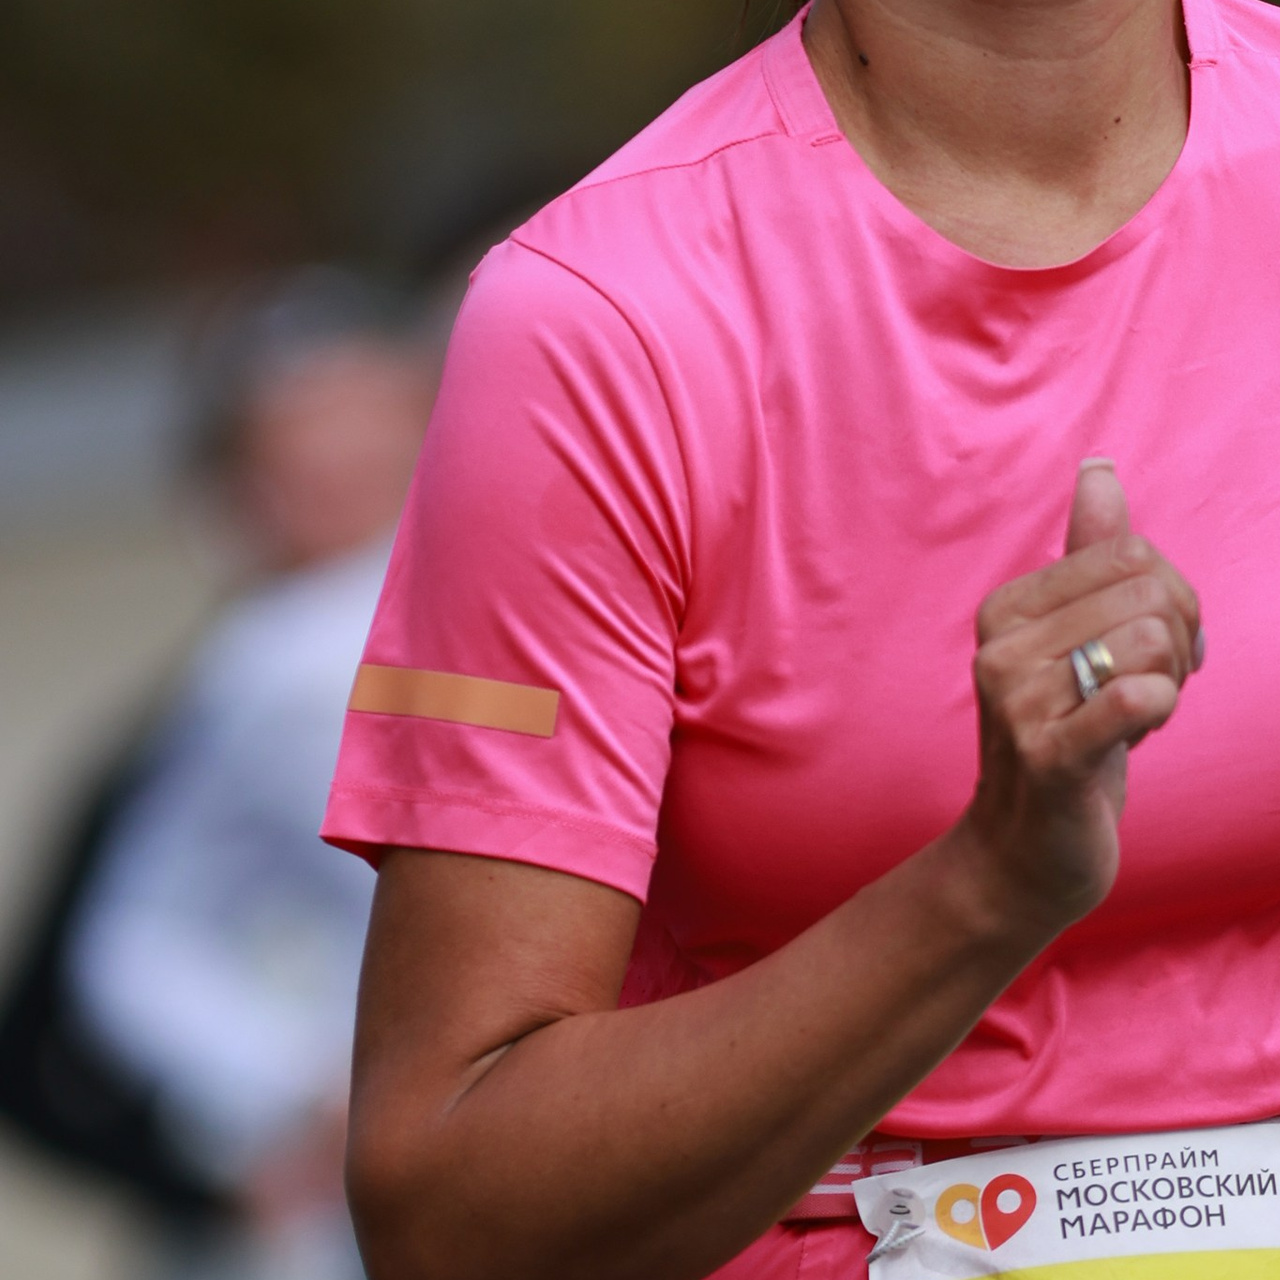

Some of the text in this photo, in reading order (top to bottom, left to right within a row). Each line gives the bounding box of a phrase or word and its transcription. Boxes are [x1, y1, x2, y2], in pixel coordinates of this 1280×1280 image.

[1053, 1146, 1220, 1182] СБЕРПРАЙМ
[1056, 1168, 1278, 1211] МОСКОВСКИЙ
[1060, 1203, 1227, 1240] МАРАФОН
